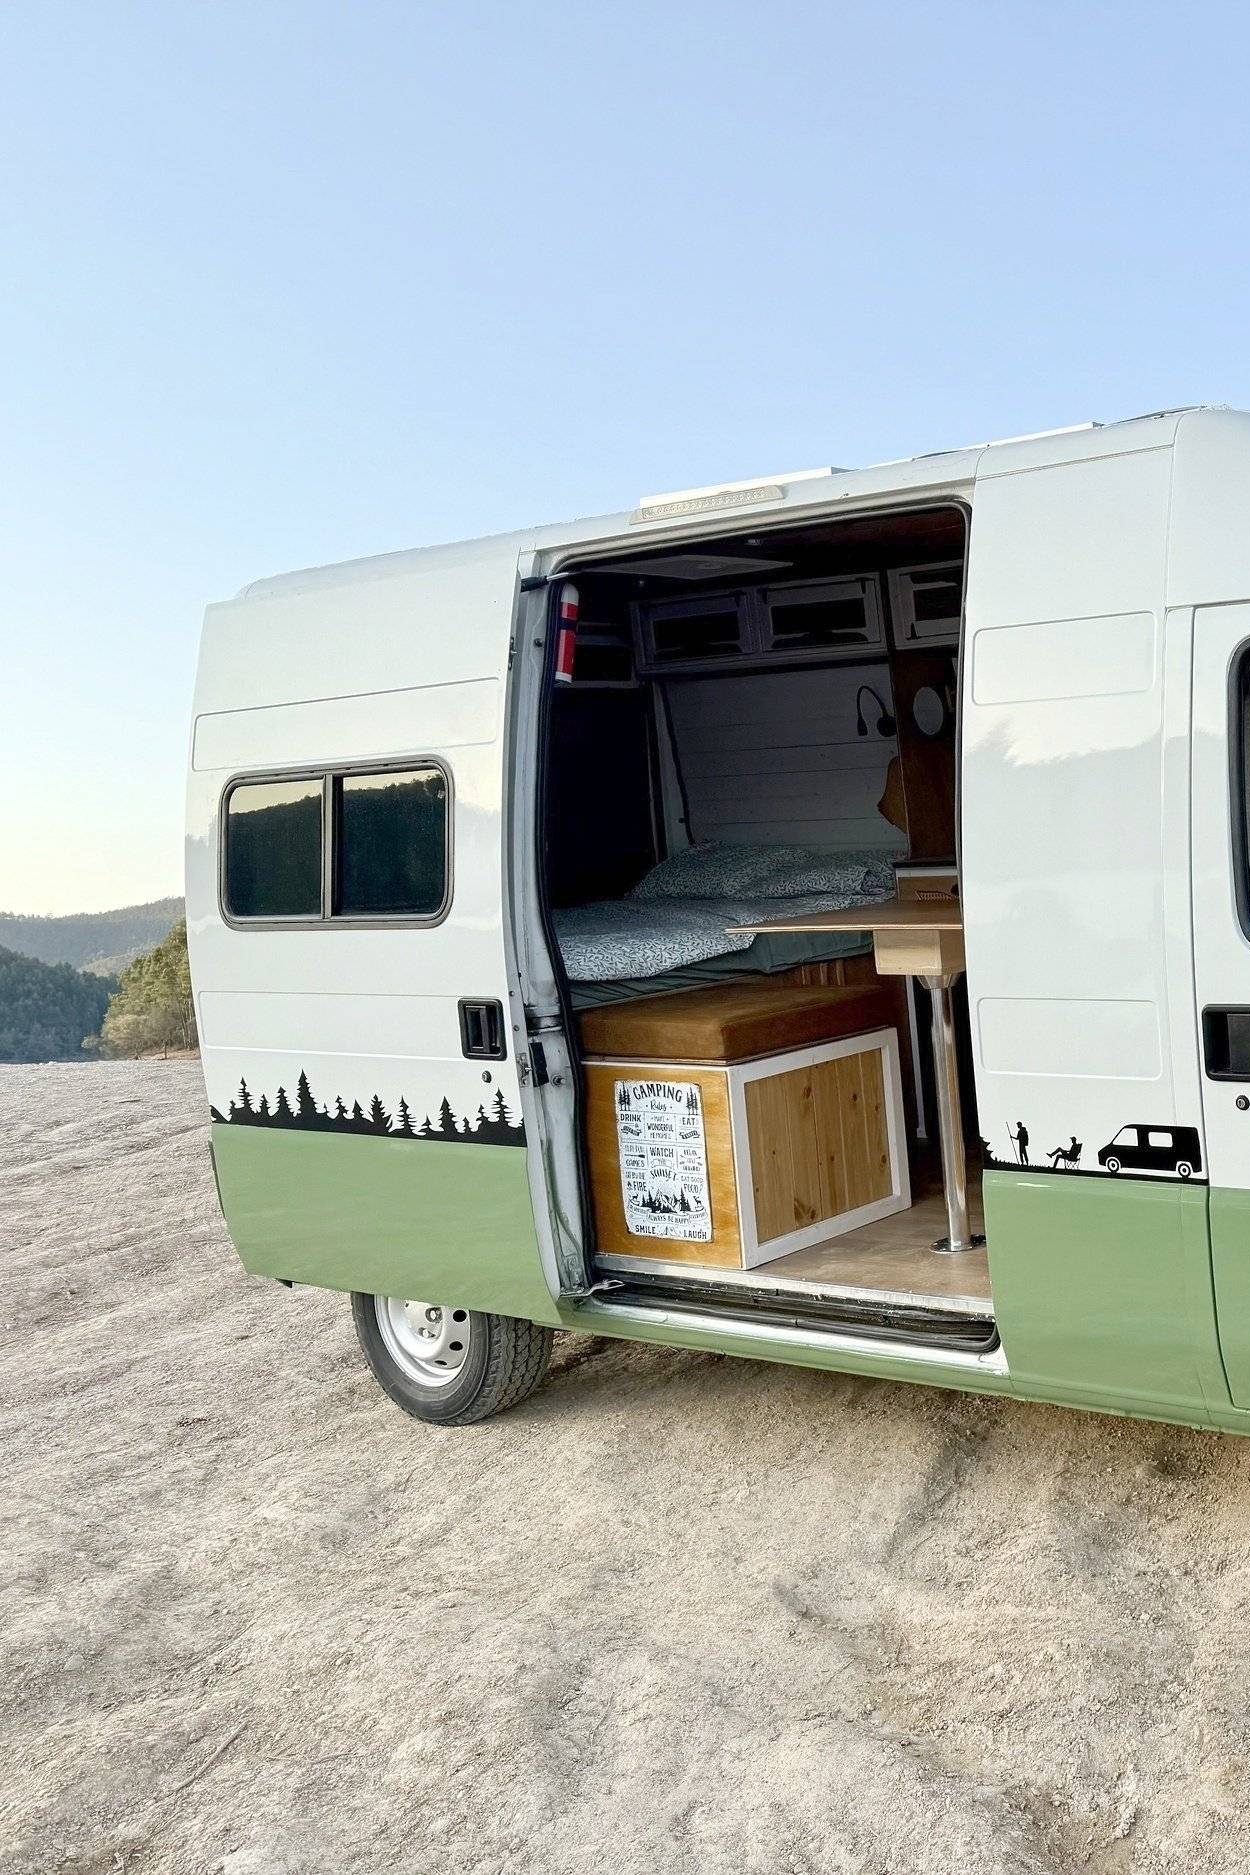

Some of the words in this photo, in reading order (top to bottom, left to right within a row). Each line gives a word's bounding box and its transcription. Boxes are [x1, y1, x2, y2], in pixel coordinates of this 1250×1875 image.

[633, 1083, 682, 1103] CAMPING
[650, 1099, 667, 1111] Rules
[620, 1113, 642, 1123] DRINK
[682, 1117, 695, 1126] EAT
[646, 1122, 674, 1132] WONDERFUL
[649, 1146, 674, 1158] WATCH
[626, 1159, 645, 1168] GAMES
[633, 1181, 647, 1192] FIRE
[635, 1224, 656, 1235] SMILE
[683, 1229, 707, 1240] LAUGH
